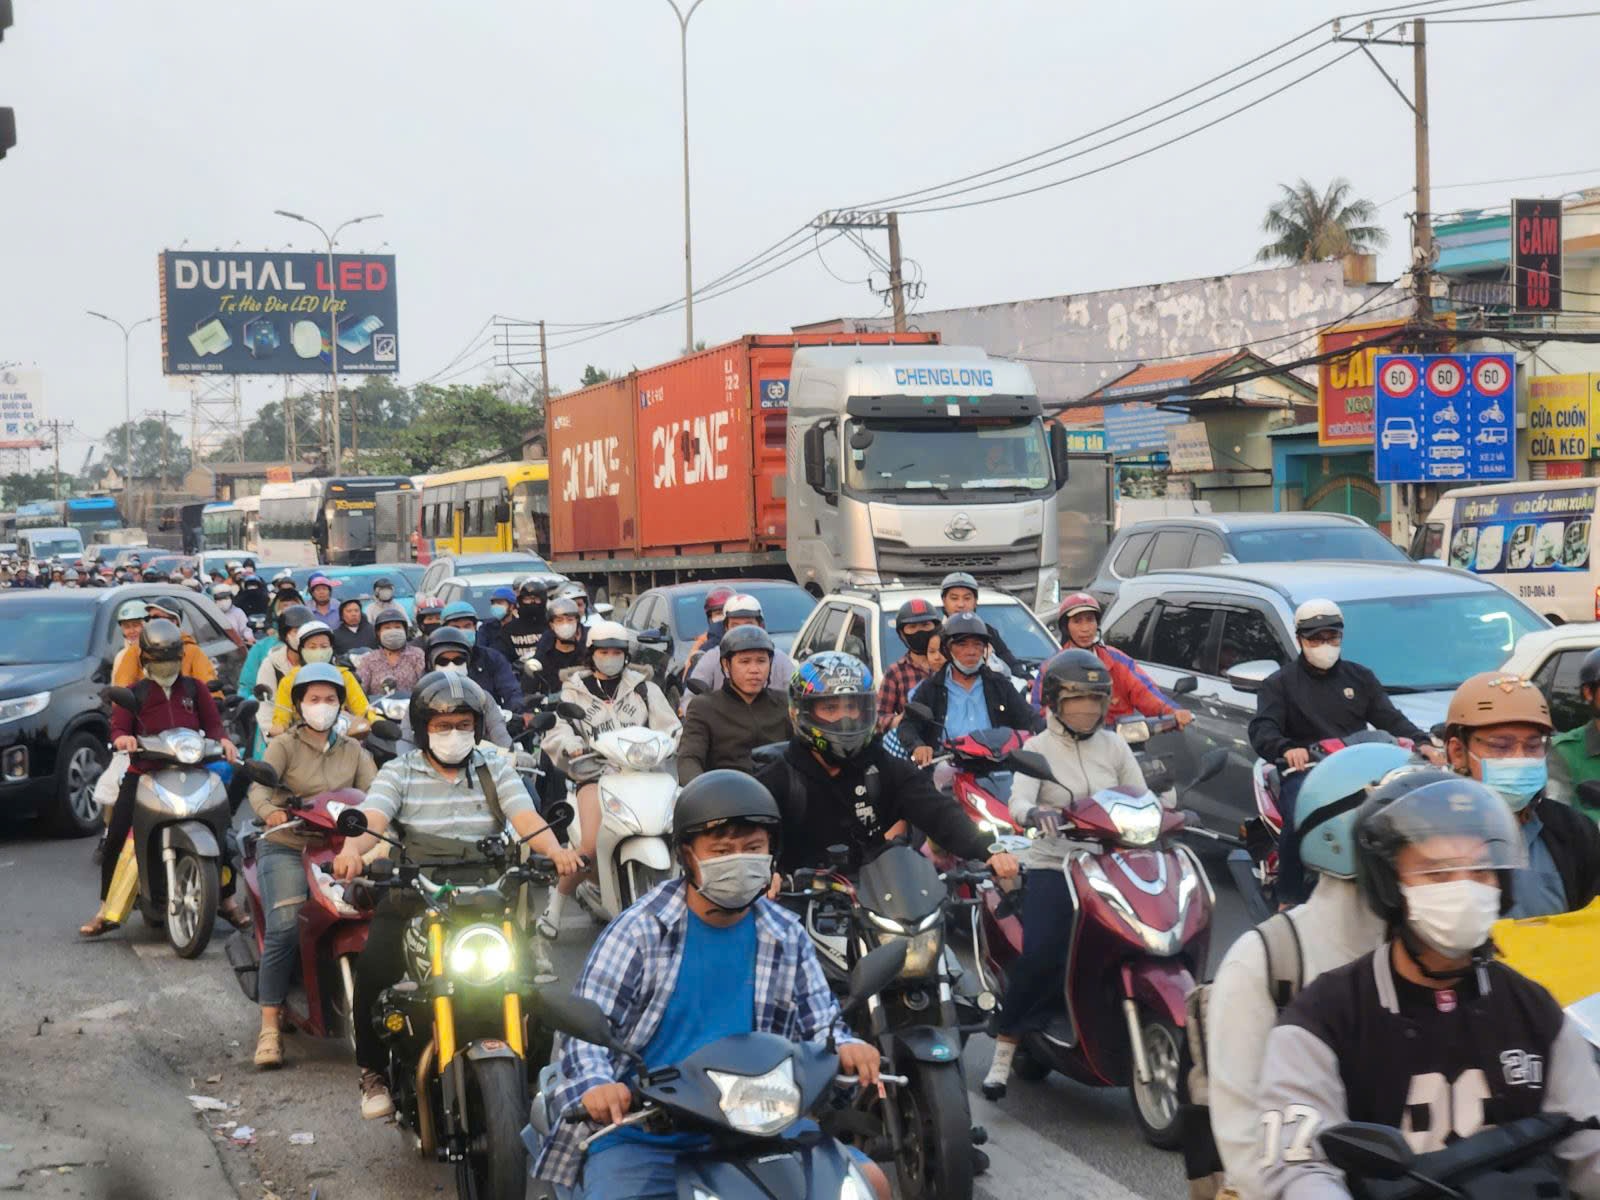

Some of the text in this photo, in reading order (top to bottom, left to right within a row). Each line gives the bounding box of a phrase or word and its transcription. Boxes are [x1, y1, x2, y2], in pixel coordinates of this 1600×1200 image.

[175, 259, 388, 292] DUHAL LED
[290, 295, 320, 313] LED
[895, 367, 993, 387] CHENGLONG
[1390, 370, 1406, 386] 60
[1437, 370, 1453, 385] 60
[1484, 369, 1499, 385] 60
[1560, 434, 1585, 456] KÉO
[1259, 1103, 1323, 1169] 17
